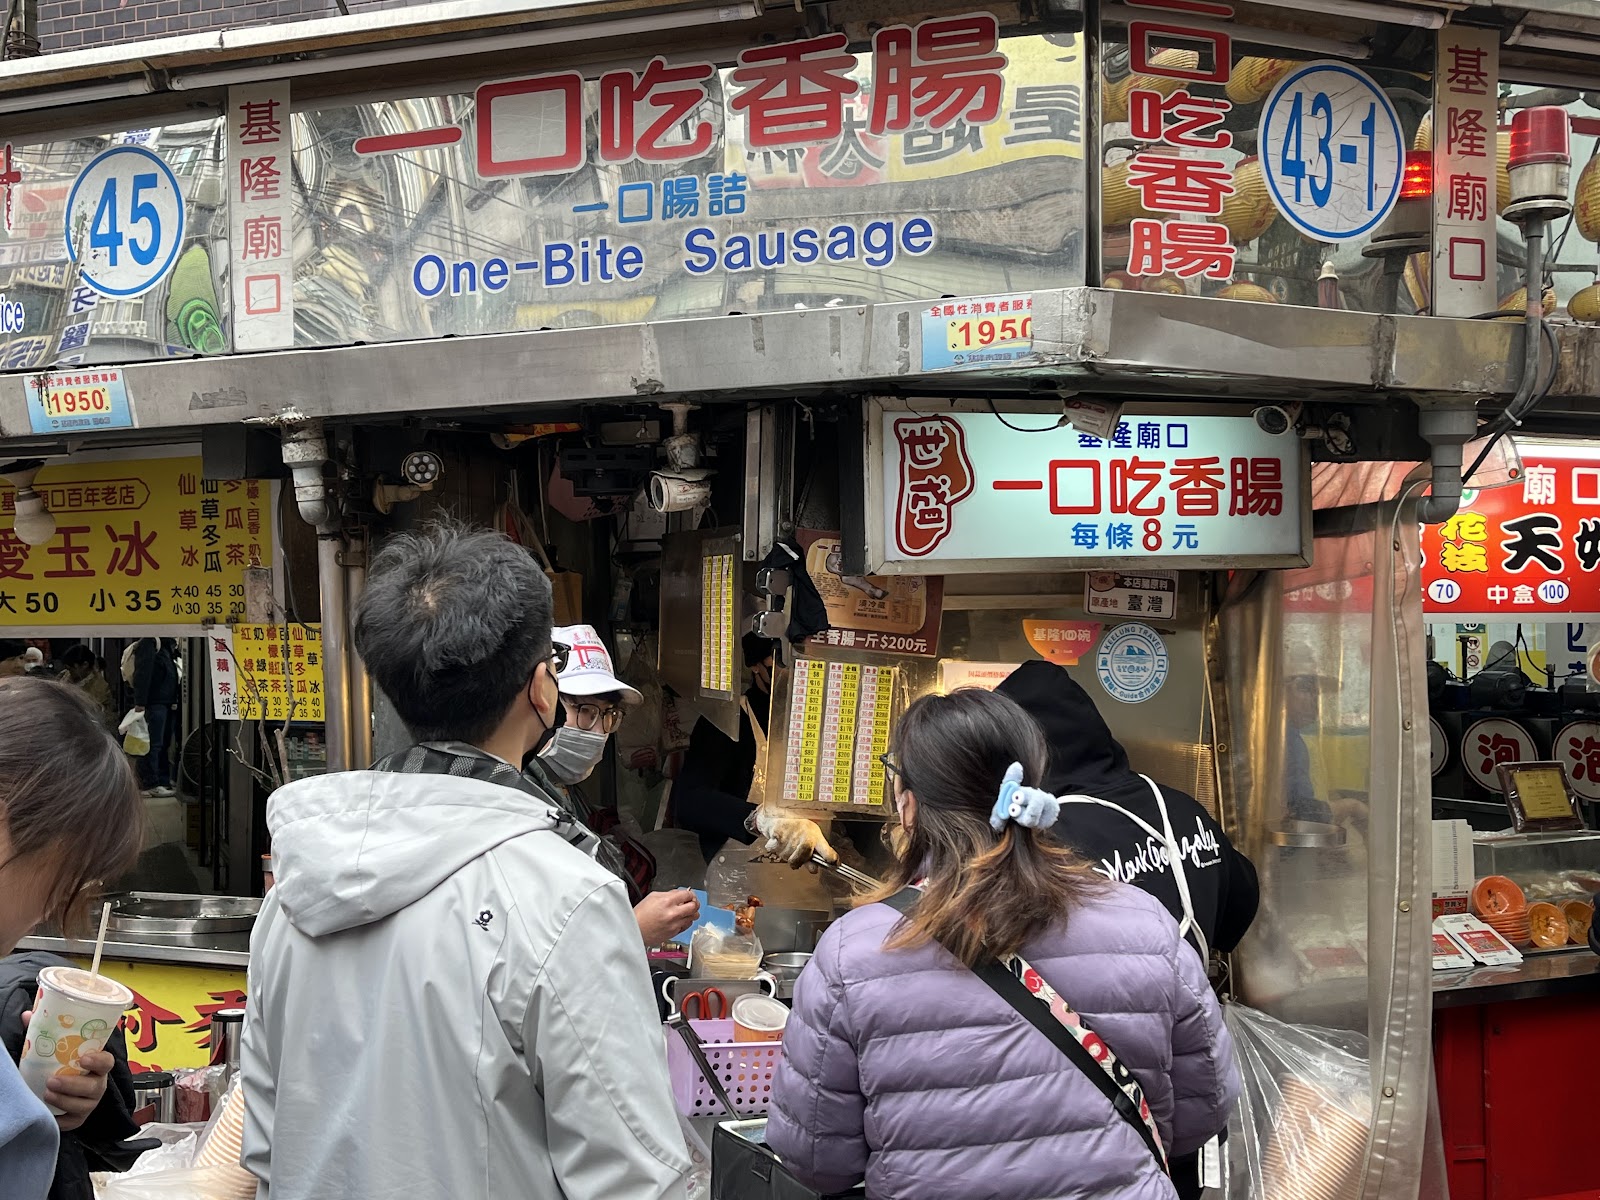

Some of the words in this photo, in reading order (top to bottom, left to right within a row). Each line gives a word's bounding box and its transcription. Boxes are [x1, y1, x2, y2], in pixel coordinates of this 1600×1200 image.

[355, 16, 1007, 178] 一口吃香腸
[1282, 91, 1377, 212] 43-1
[1447, 45, 1488, 281] 基隆廟口
[239, 99, 282, 315] 基隆廟口
[573, 172, 747, 223] 一口腸詰
[90, 172, 163, 267] 45
[413, 239, 644, 297] One-Bite
[685, 217, 933, 273] Sausage
[51, 389, 104, 414] 1950
[992, 455, 1283, 517] 一口吃香腸
[177, 473, 200, 567] 仙草冰
[1070, 517, 1199, 551] 每條8元
[26, 592, 59, 614] 50
[89, 588, 116, 612] 小
[125, 590, 162, 612] 35
[205, 585, 221, 597] 45
[229, 584, 245, 597] 30
[1436, 584, 1454, 599] 70
[1487, 584, 1535, 605] 中盒
[1542, 584, 1564, 600] 100
[207, 602, 222, 614] 35
[1104, 626, 1136, 650] KEELUNG
[1138, 626, 1163, 652] TRAVEL
[292, 627, 308, 693] 仙草冬瓜
[221, 704, 231, 716] 20
[273, 696, 282, 706] 30
[311, 697, 320, 707] 40
[274, 708, 282, 717] 25
[299, 708, 308, 718] 35
[312, 709, 321, 718] 30
